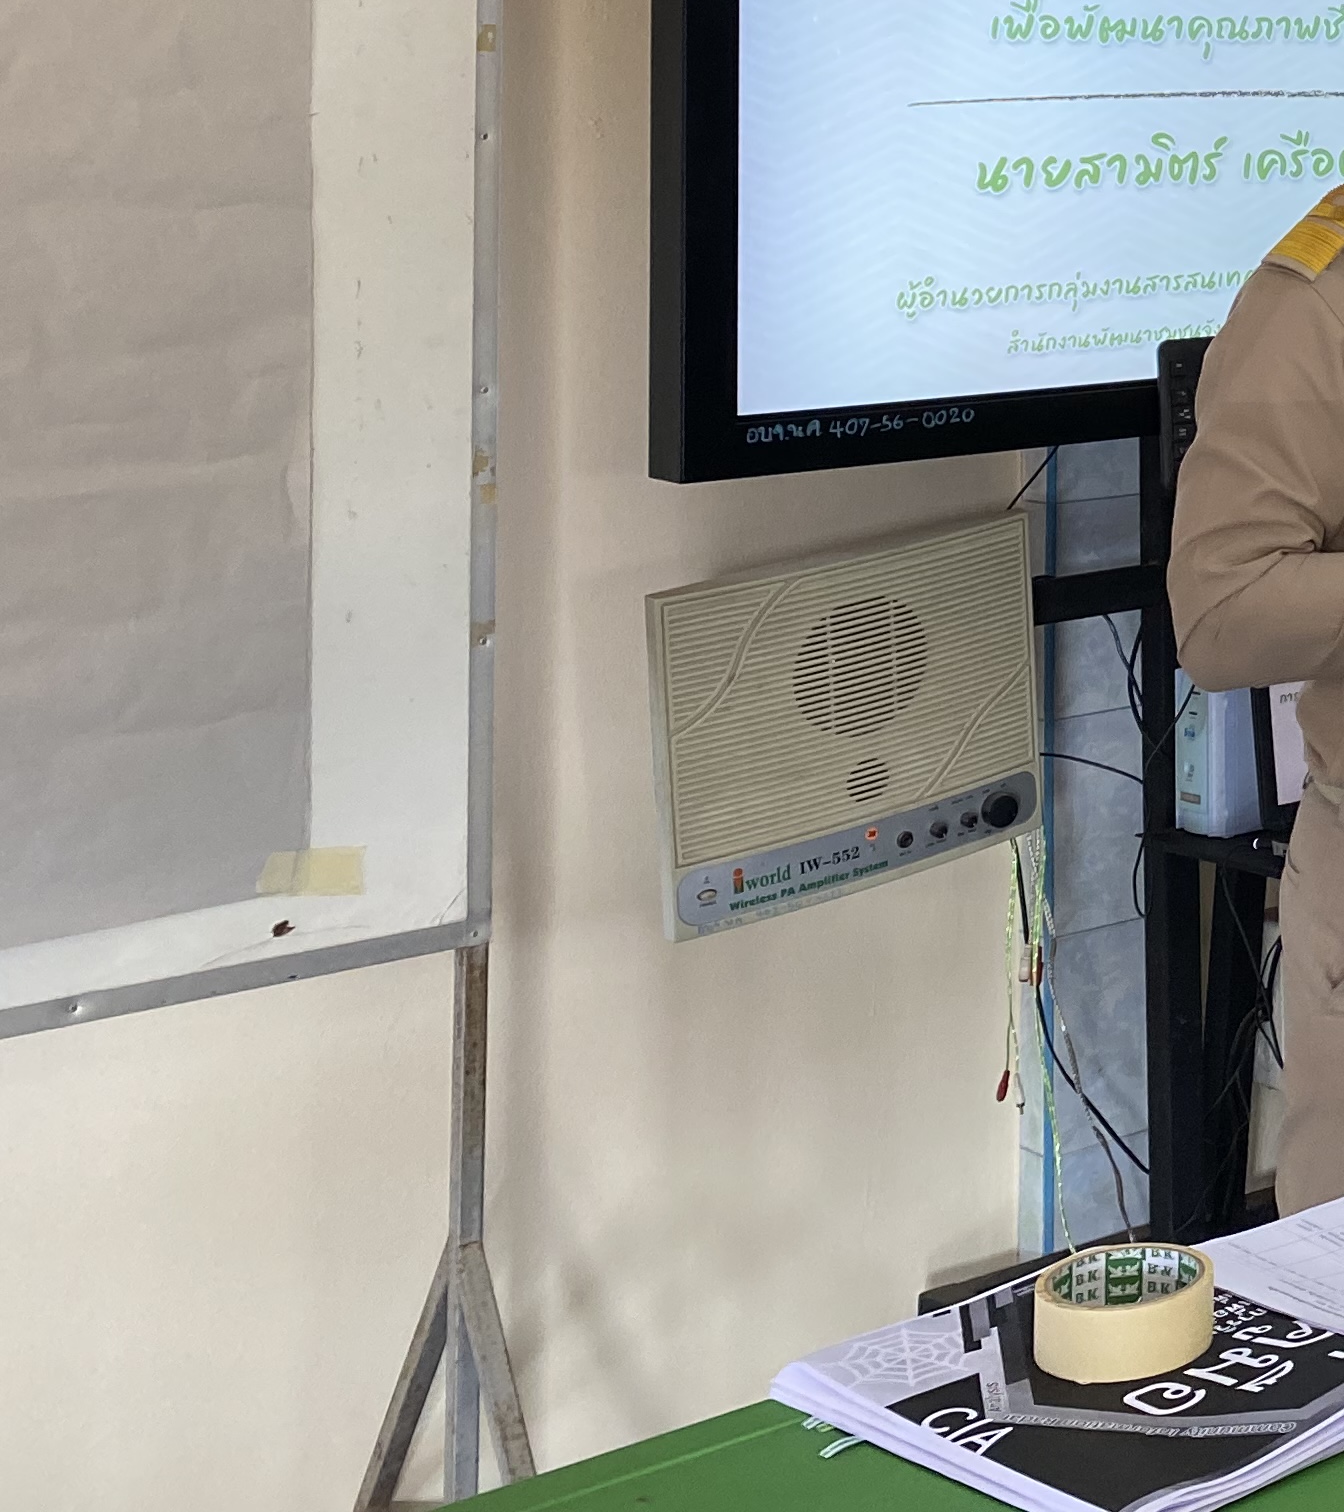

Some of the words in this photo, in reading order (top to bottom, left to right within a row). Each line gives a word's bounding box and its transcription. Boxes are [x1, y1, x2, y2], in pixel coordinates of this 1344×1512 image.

[975, 132, 1228, 192] นายสามิตร์
[829, 407, 975, 438] 407-56-0020
[799, 846, 860, 875] IW-552
[729, 891, 778, 912] Wireless
[780, 886, 796, 900] PA
[799, 872, 850, 894] Amplifier
[853, 860, 889, 878] System
[1184, 1420, 1297, 1439] Community
